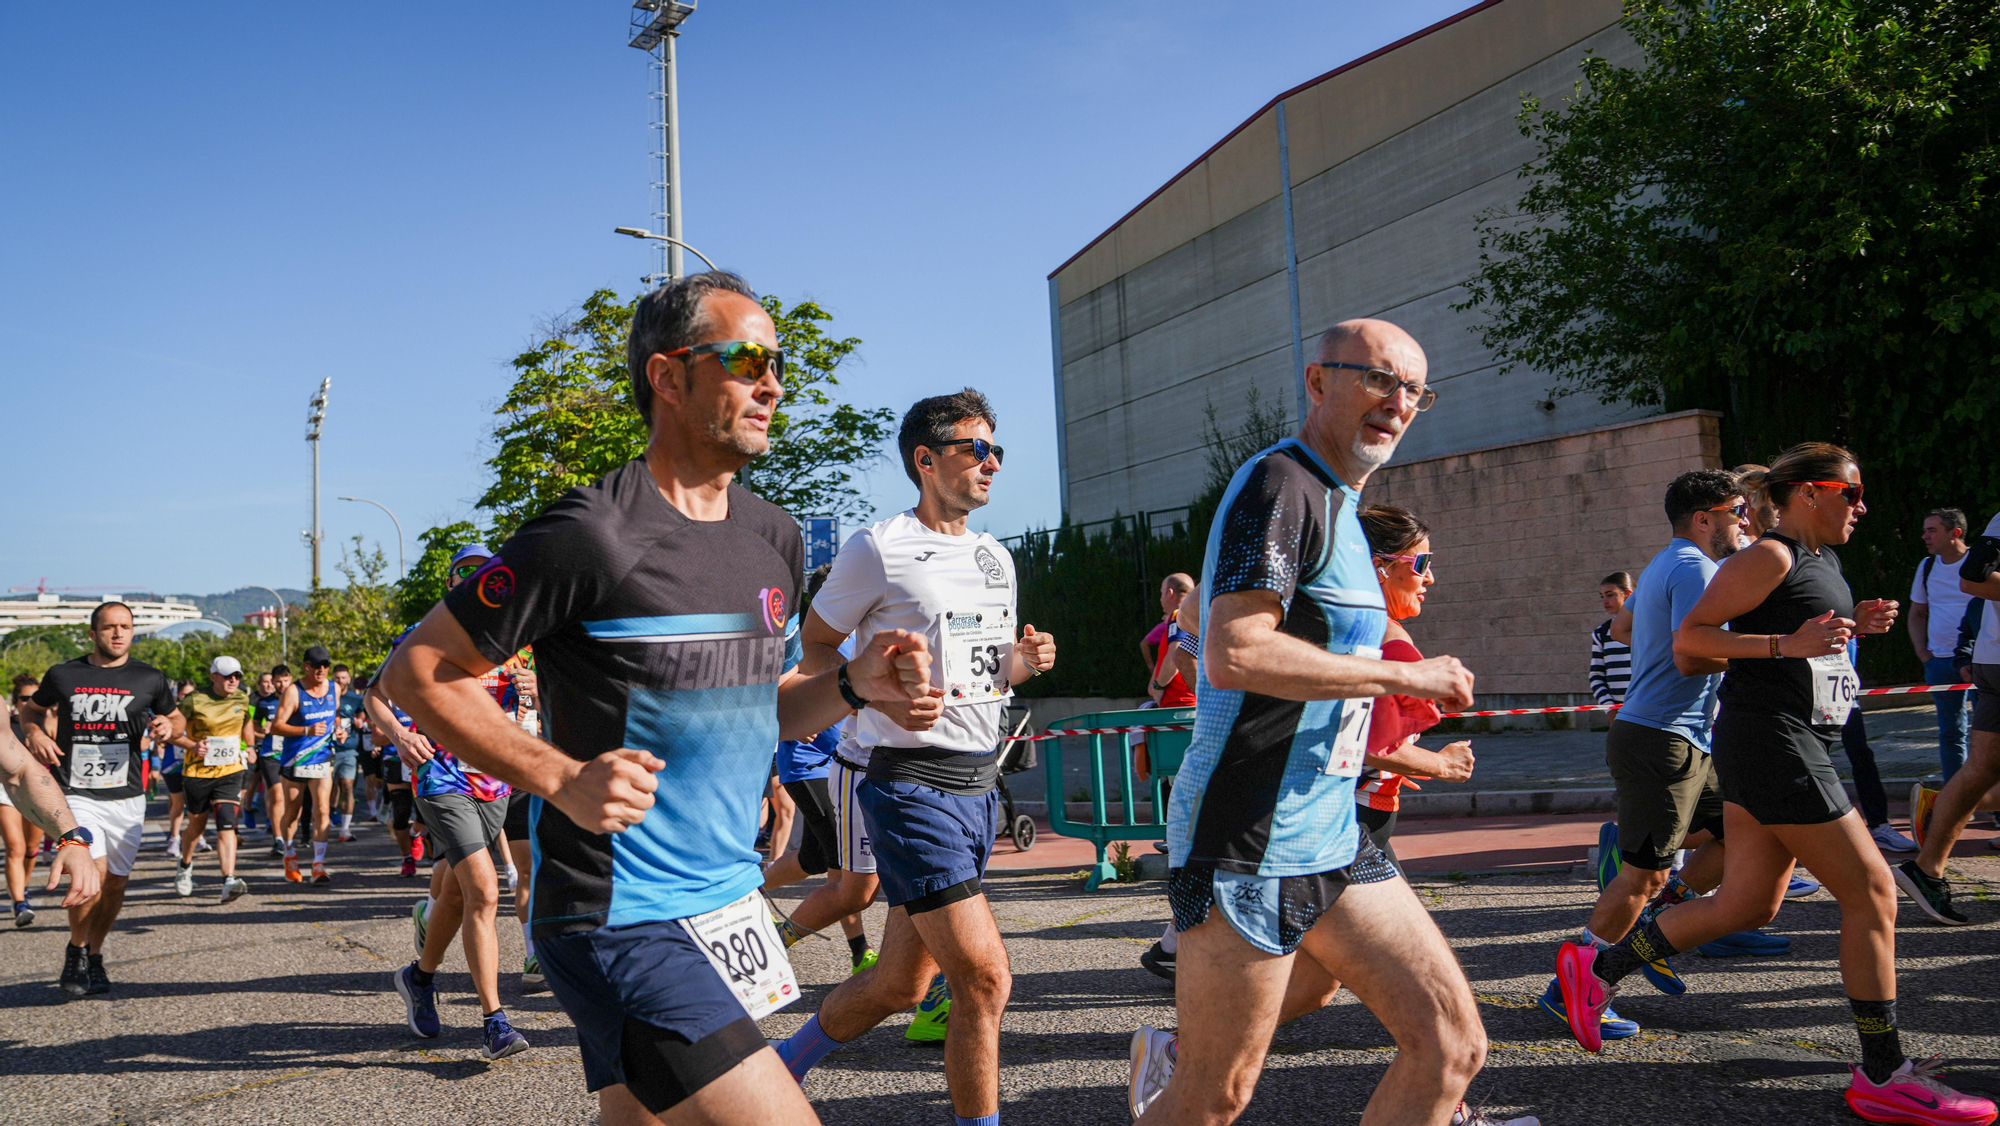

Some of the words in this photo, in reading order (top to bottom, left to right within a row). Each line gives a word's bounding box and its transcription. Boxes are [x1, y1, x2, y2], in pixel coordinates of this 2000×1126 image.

[948, 615, 976, 624] arreras
[971, 645, 1000, 677] 53
[1827, 675, 1857, 702] 765
[213, 748, 234, 757] 265
[83, 762, 119, 776] 237
